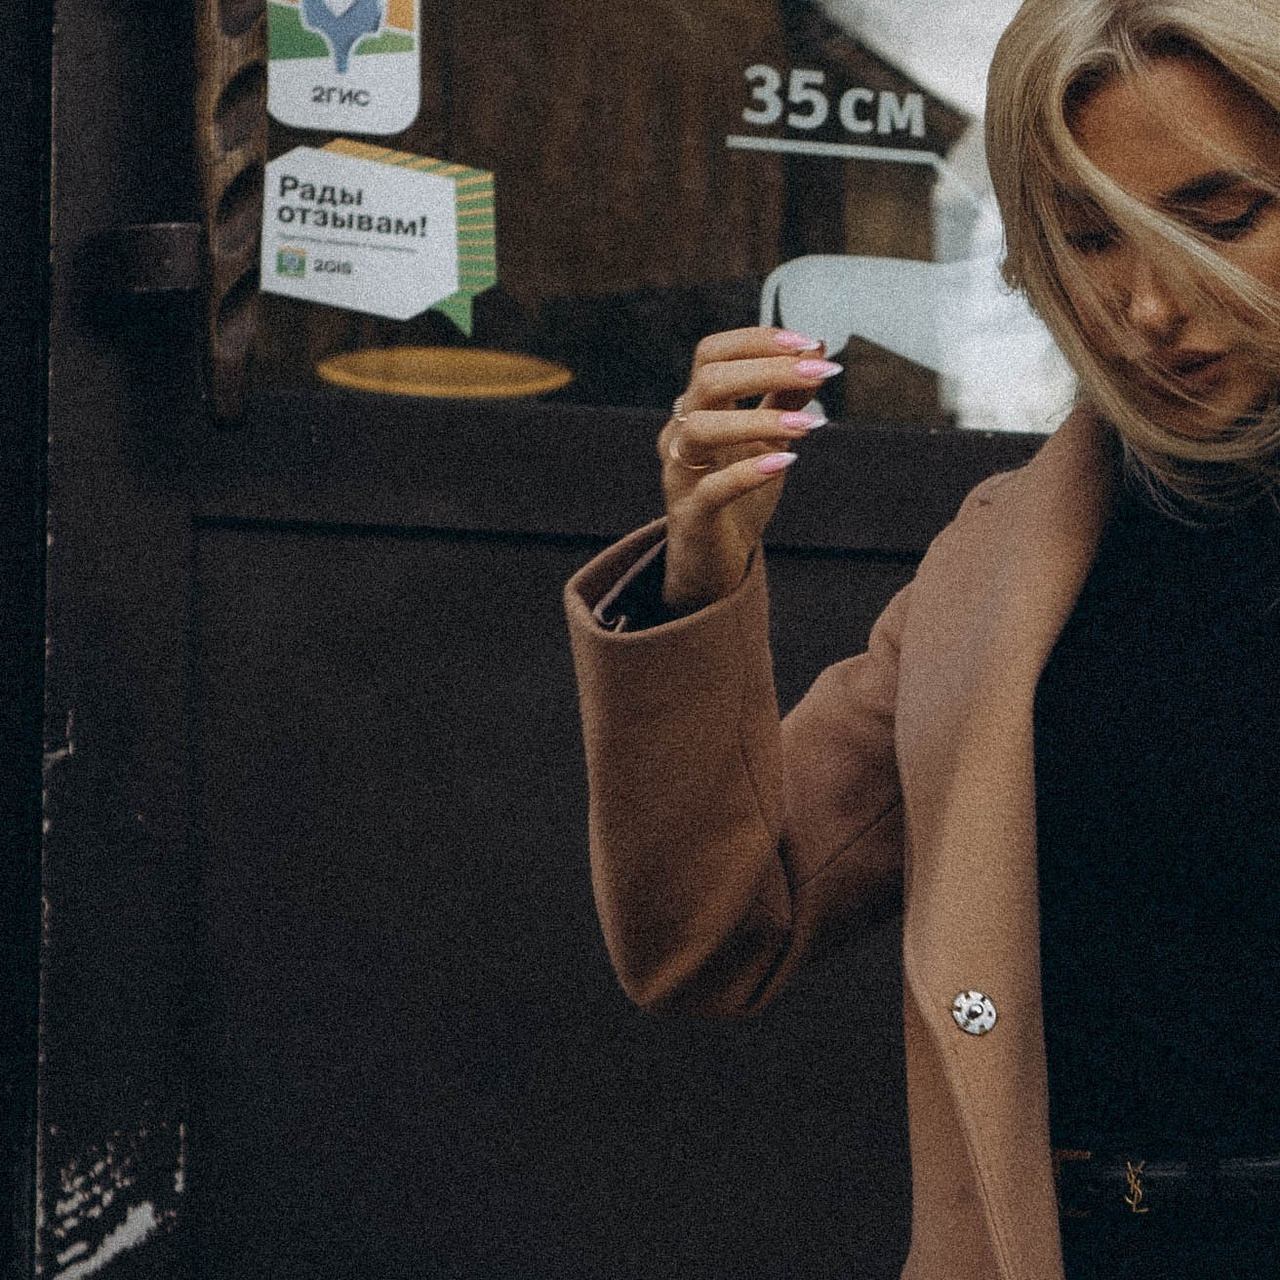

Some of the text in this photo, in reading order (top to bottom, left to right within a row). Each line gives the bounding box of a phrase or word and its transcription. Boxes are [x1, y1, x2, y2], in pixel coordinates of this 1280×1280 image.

[310, 86, 372, 107] 2ГИС
[741, 64, 829, 131] 35
[280, 175, 364, 207] Рады
[277, 205, 428, 238] отзывам!
